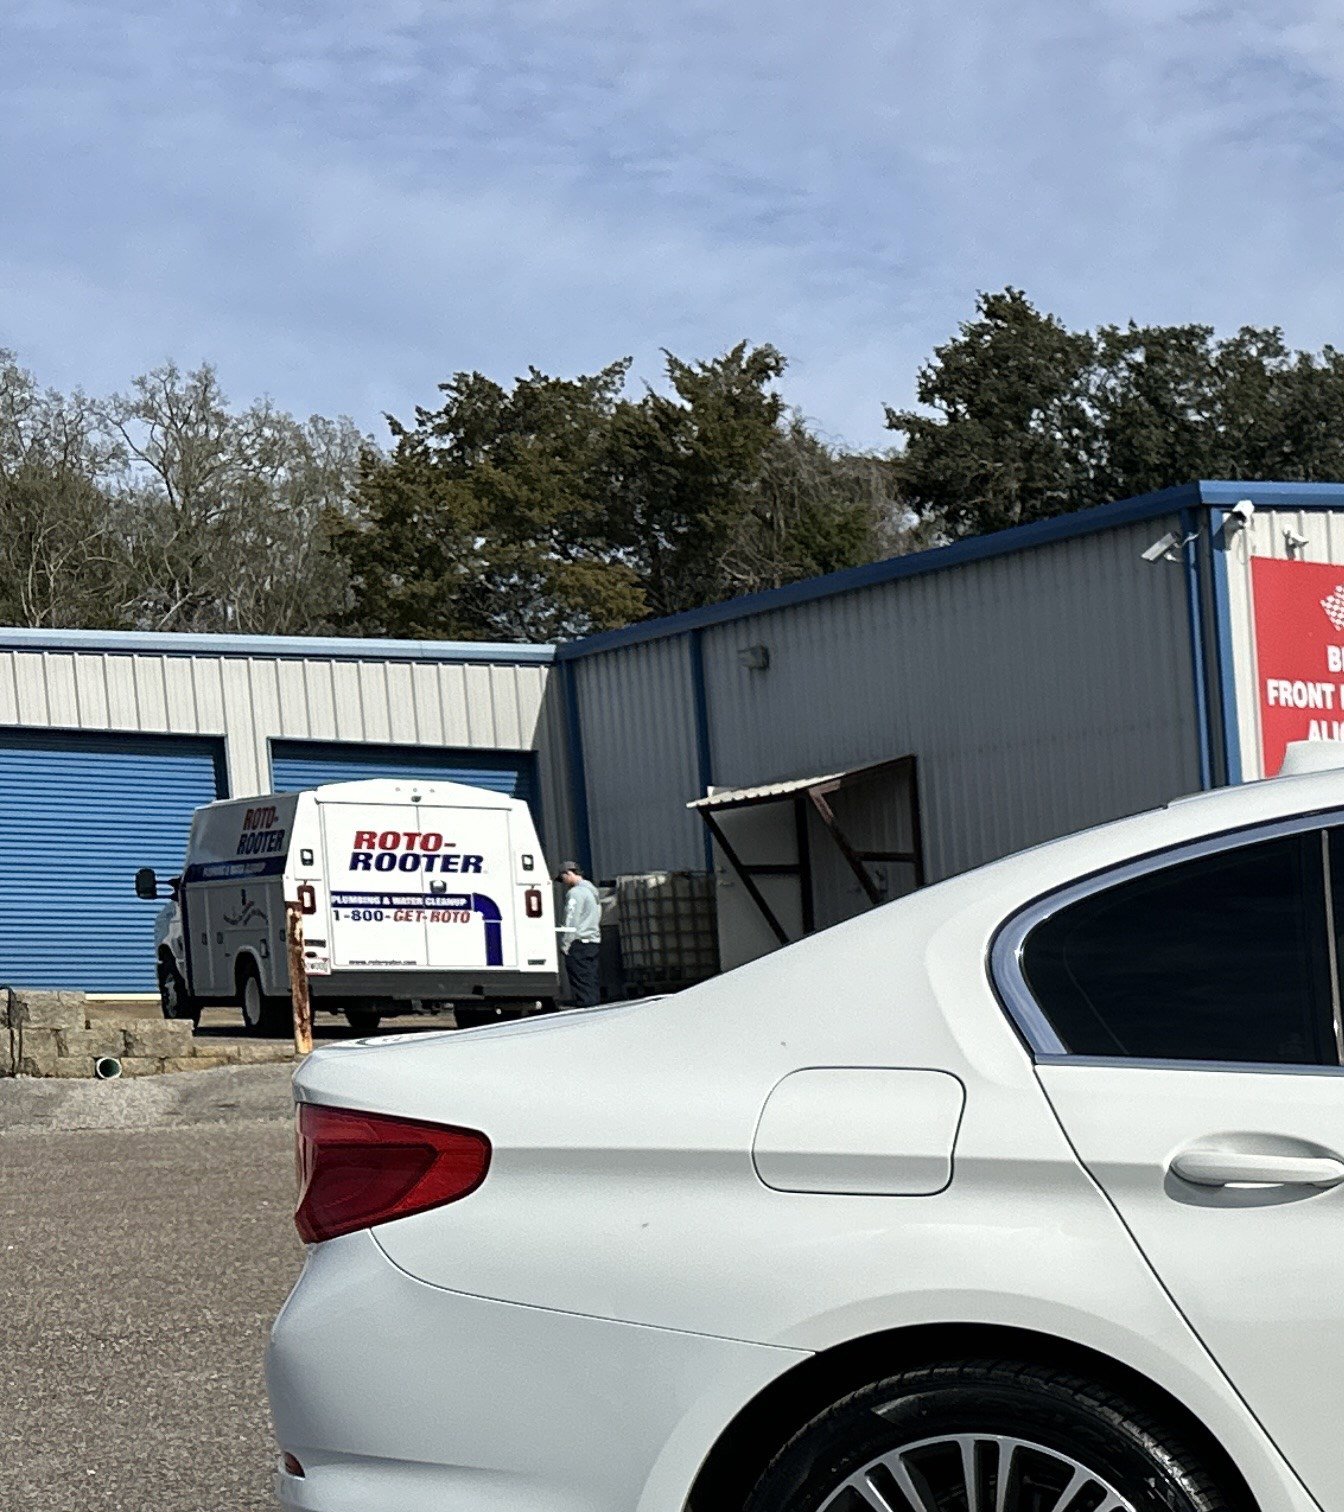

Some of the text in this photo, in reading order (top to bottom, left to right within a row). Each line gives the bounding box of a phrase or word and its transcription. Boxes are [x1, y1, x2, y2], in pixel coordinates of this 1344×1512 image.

[1266, 678, 1335, 709] FRONT
[243, 806, 279, 830] ROTO-
[236, 829, 285, 855] ROOTER
[353, 831, 457, 852] ROTO-
[349, 852, 484, 873] ROOTER
